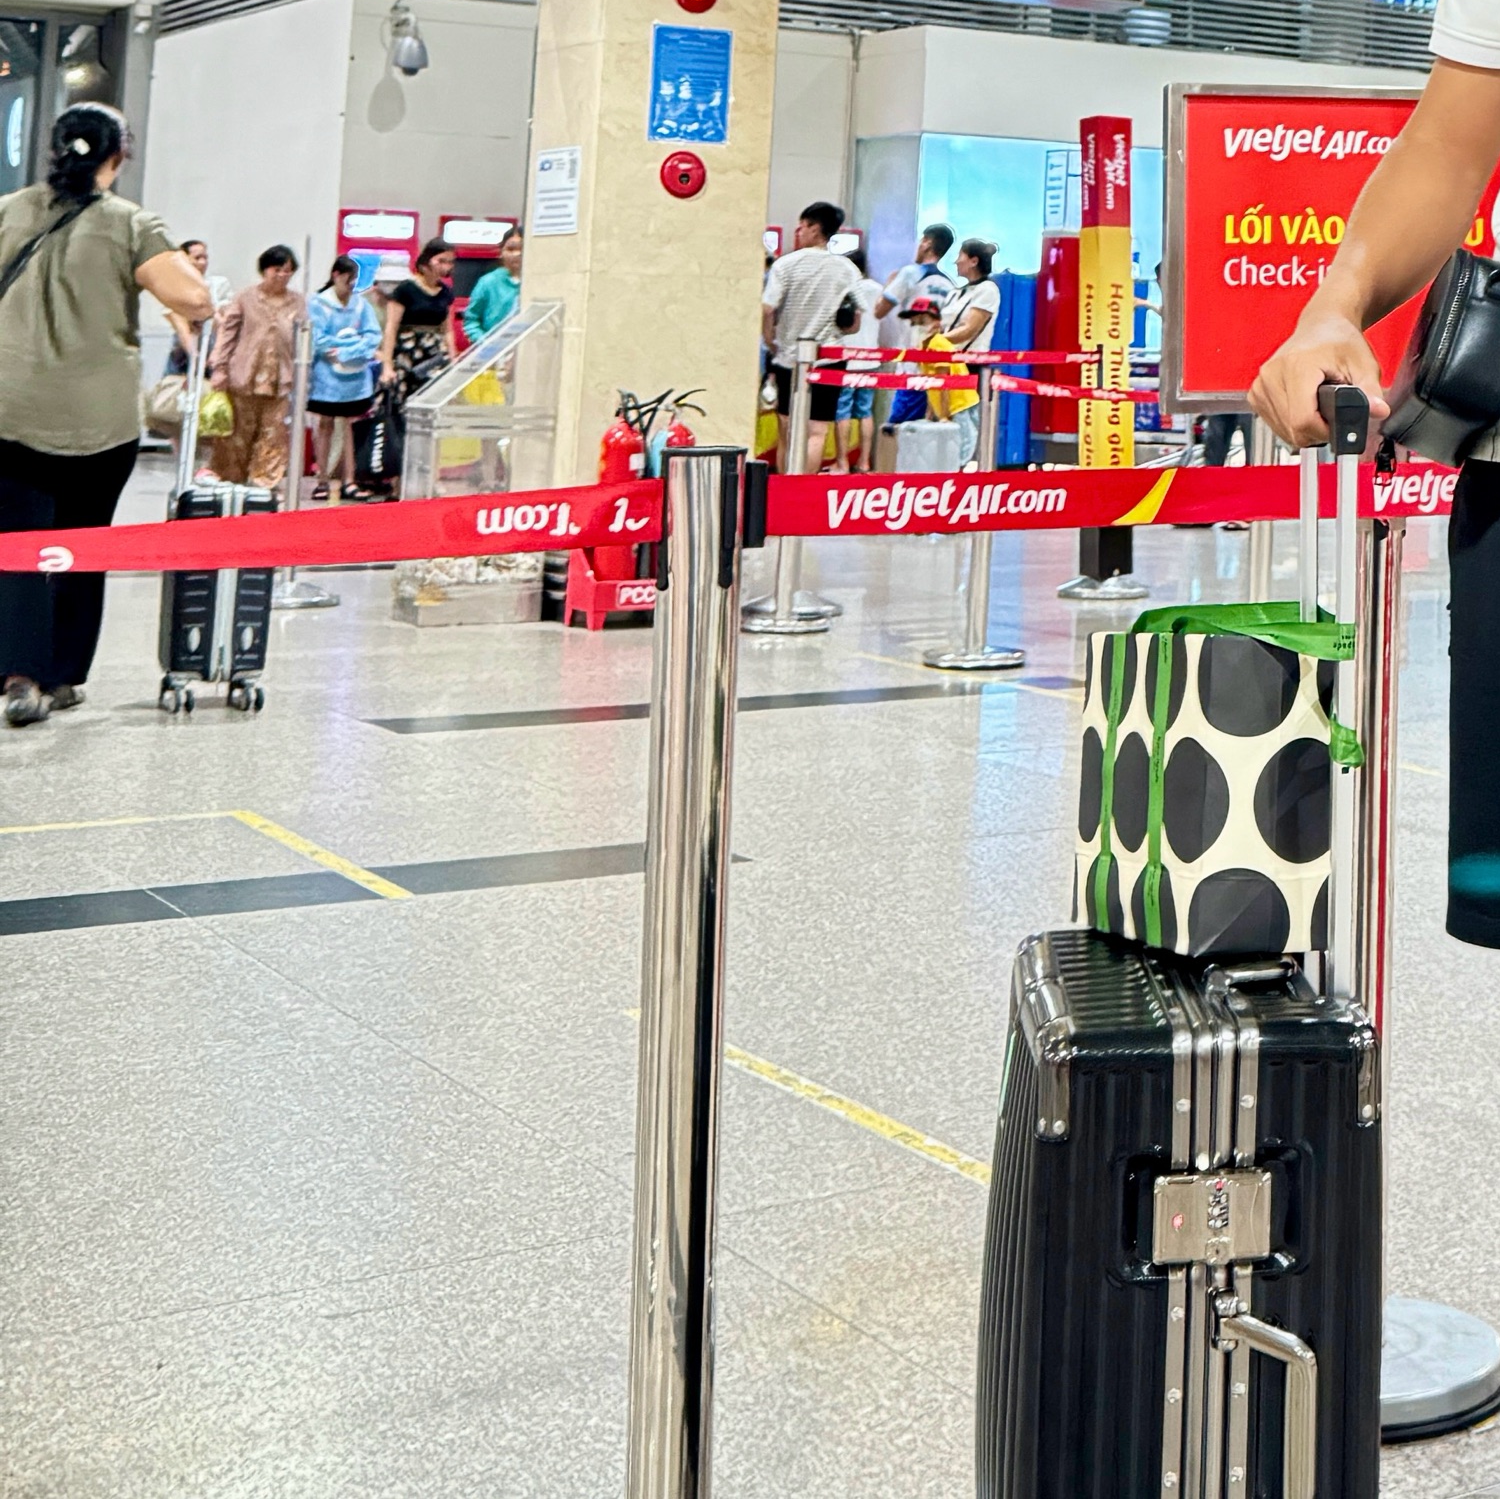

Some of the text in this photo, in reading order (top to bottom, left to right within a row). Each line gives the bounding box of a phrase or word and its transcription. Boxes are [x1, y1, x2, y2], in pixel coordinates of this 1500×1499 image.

[1320, 130, 1399, 160] Air.co
[1225, 203, 1345, 245] LỐI VÀO
[1223, 255, 1331, 286] Check-i
[620, 585, 656, 604] PCC
